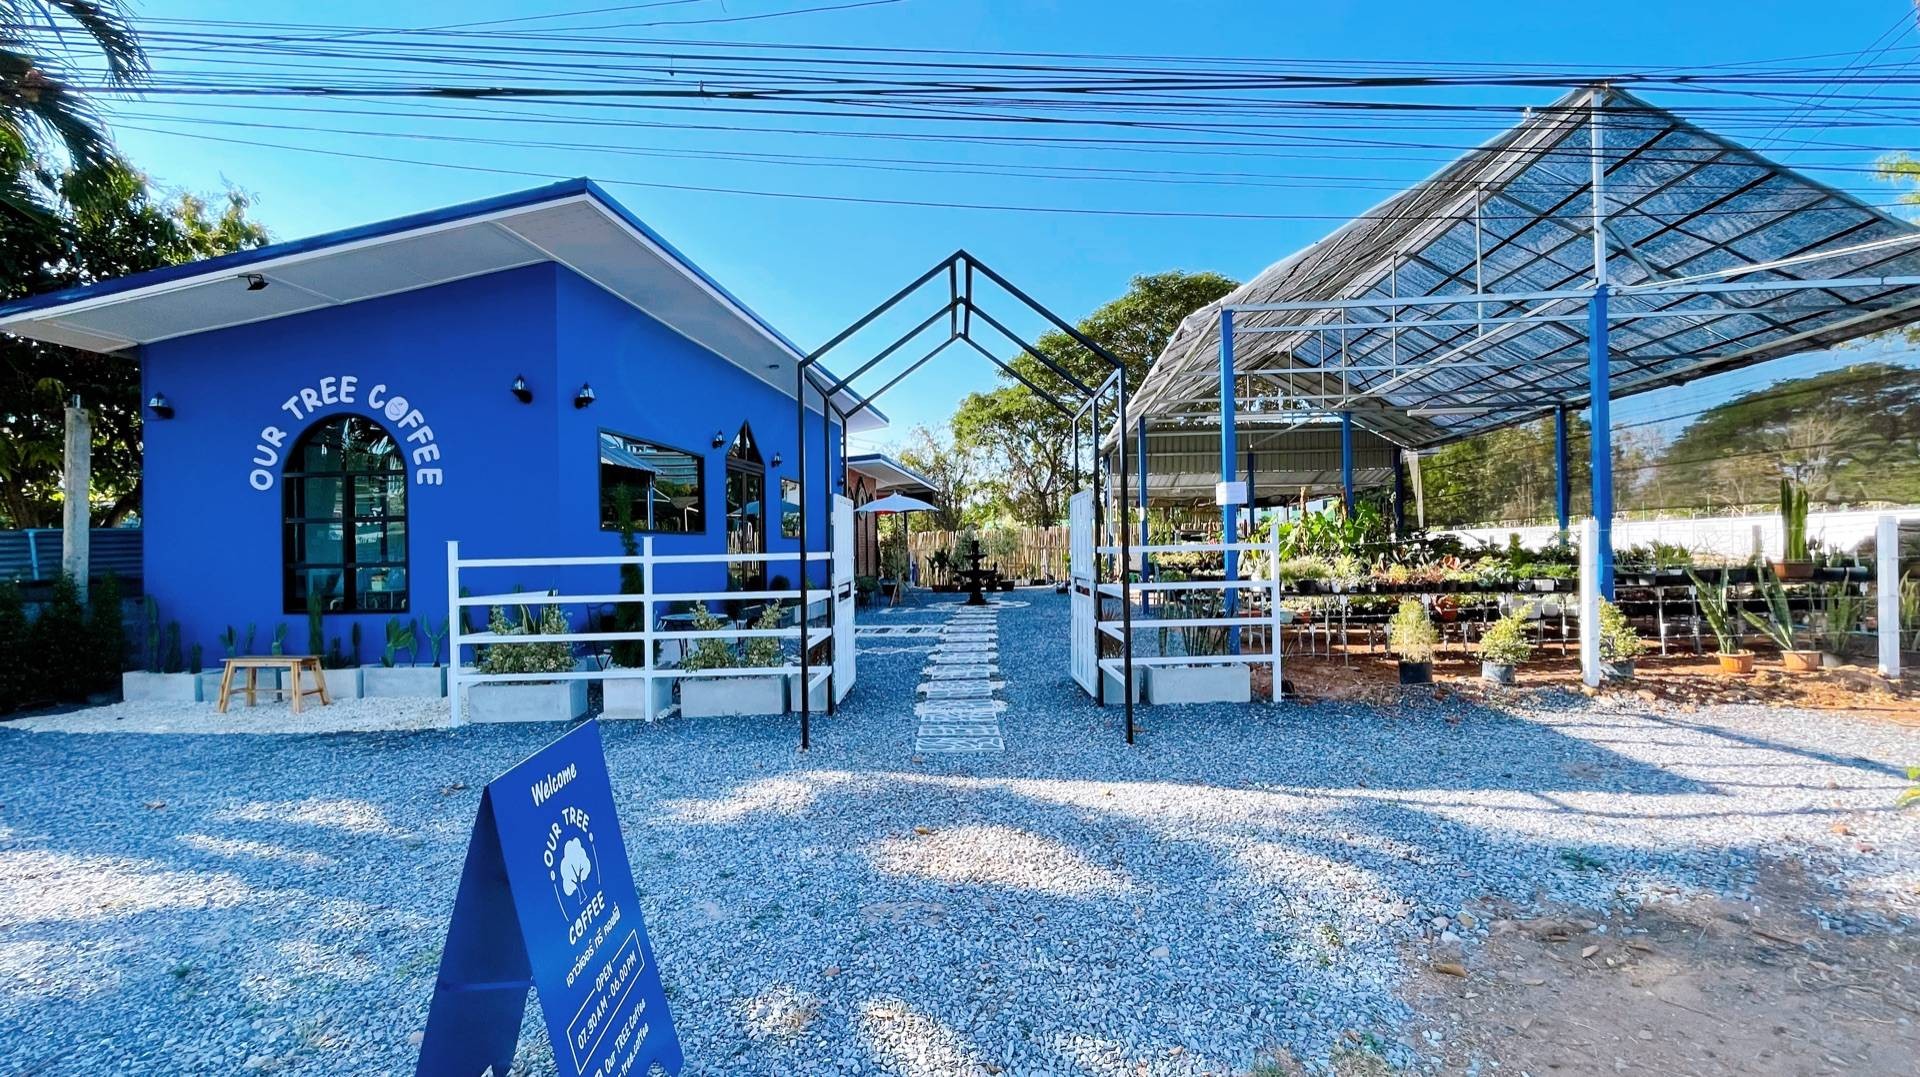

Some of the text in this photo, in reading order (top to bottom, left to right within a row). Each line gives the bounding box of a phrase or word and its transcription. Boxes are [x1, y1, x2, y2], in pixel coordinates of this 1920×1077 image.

[249, 375, 444, 491] OUR TREE COFFEE
[531, 763, 577, 807] Welcome
[543, 806, 590, 868] OUR TREE
[568, 890, 605, 945] COFFEE
[595, 960, 613, 992] OPEN
[604, 998, 646, 1074] Our TREE Coffee
